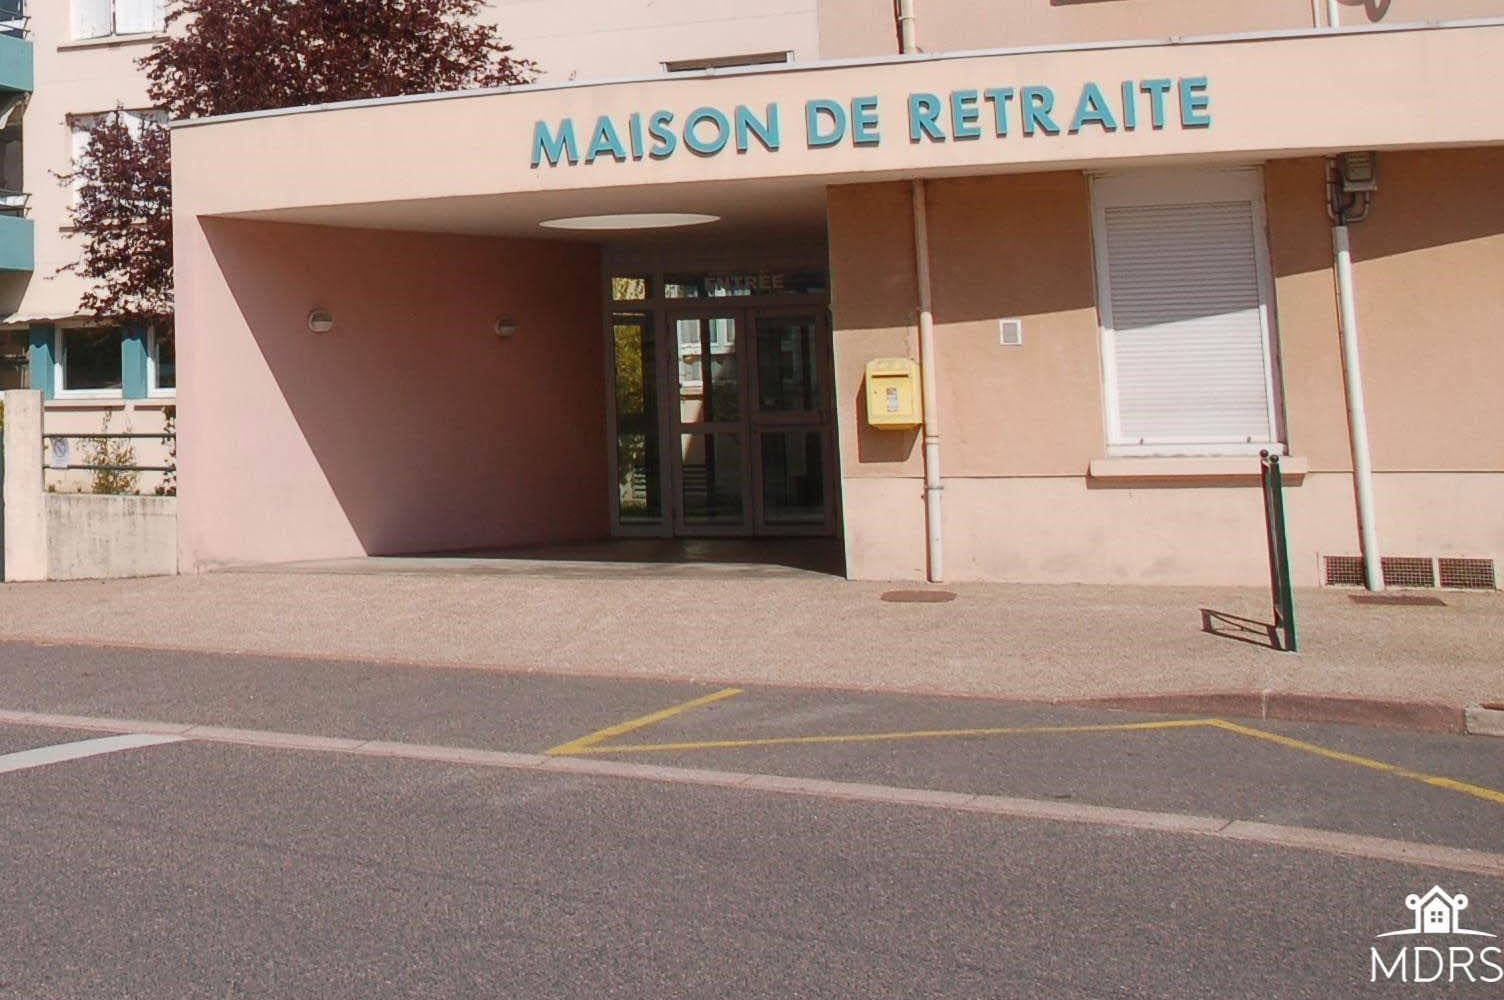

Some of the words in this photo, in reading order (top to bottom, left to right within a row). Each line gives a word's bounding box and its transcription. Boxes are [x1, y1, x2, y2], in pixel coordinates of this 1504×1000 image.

[531, 103, 780, 166] MAISON
[807, 95, 881, 148] DE
[908, 76, 1213, 141] RETRAITE
